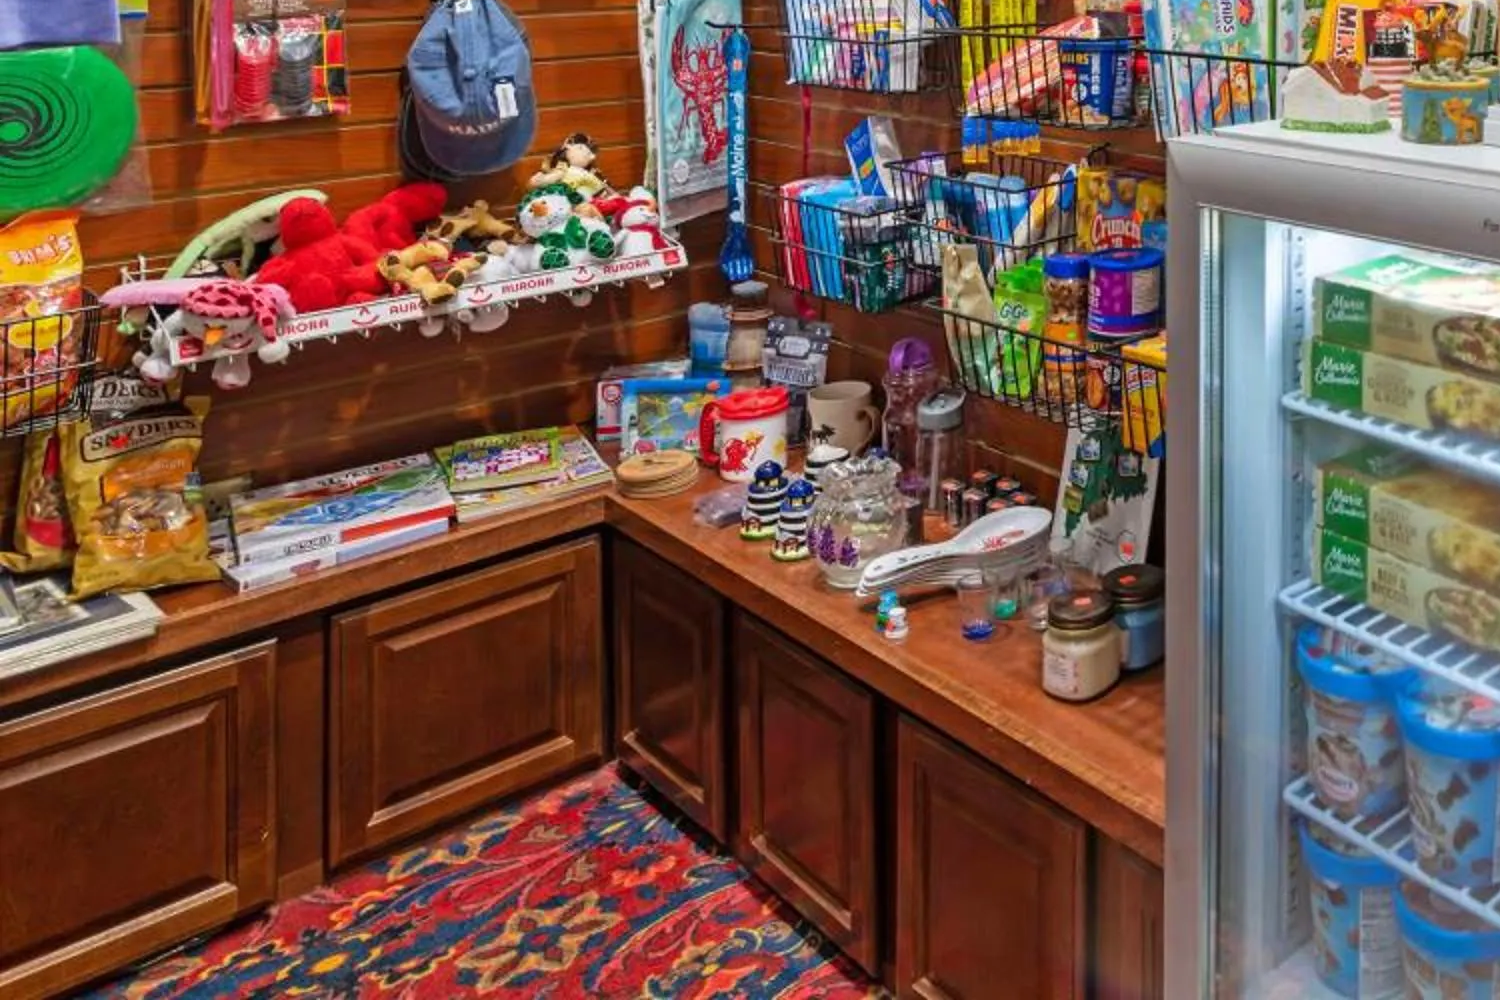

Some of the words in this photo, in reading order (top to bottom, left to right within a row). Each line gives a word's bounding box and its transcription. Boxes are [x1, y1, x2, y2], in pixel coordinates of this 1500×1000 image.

[603, 259, 650, 275] AURORA
[501, 276, 555, 294] AURORA
[275, 318, 330, 337] URORA
